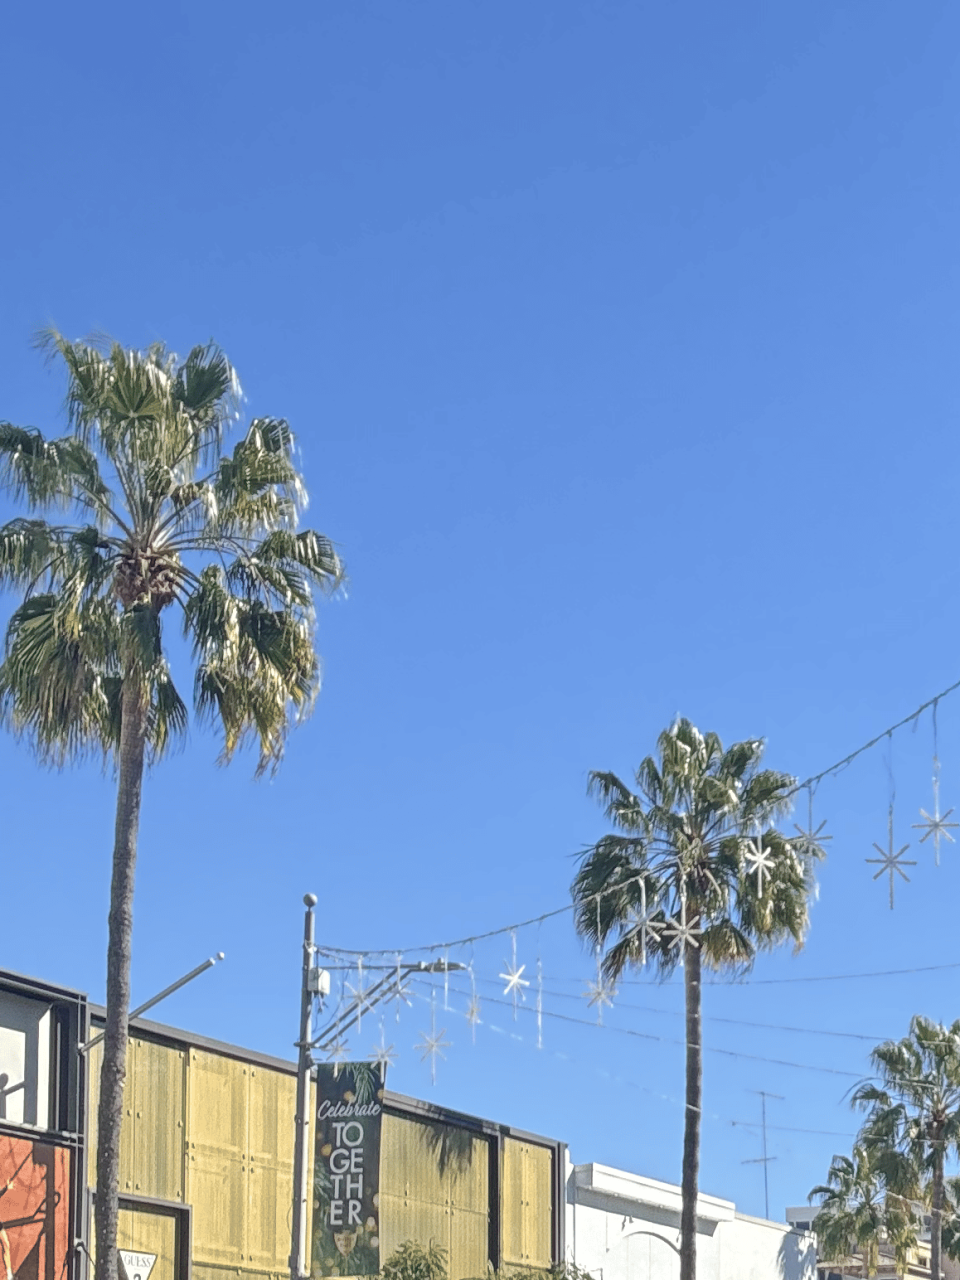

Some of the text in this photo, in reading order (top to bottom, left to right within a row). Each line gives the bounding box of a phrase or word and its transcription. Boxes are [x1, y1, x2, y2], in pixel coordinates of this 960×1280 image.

[317, 1100, 382, 1120] Celebrate
[332, 1121, 364, 1147] TO
[329, 1148, 364, 1174] GE
[330, 1174, 364, 1200] TH
[329, 1200, 363, 1226] ER
[124, 1253, 152, 1268] GUESS
